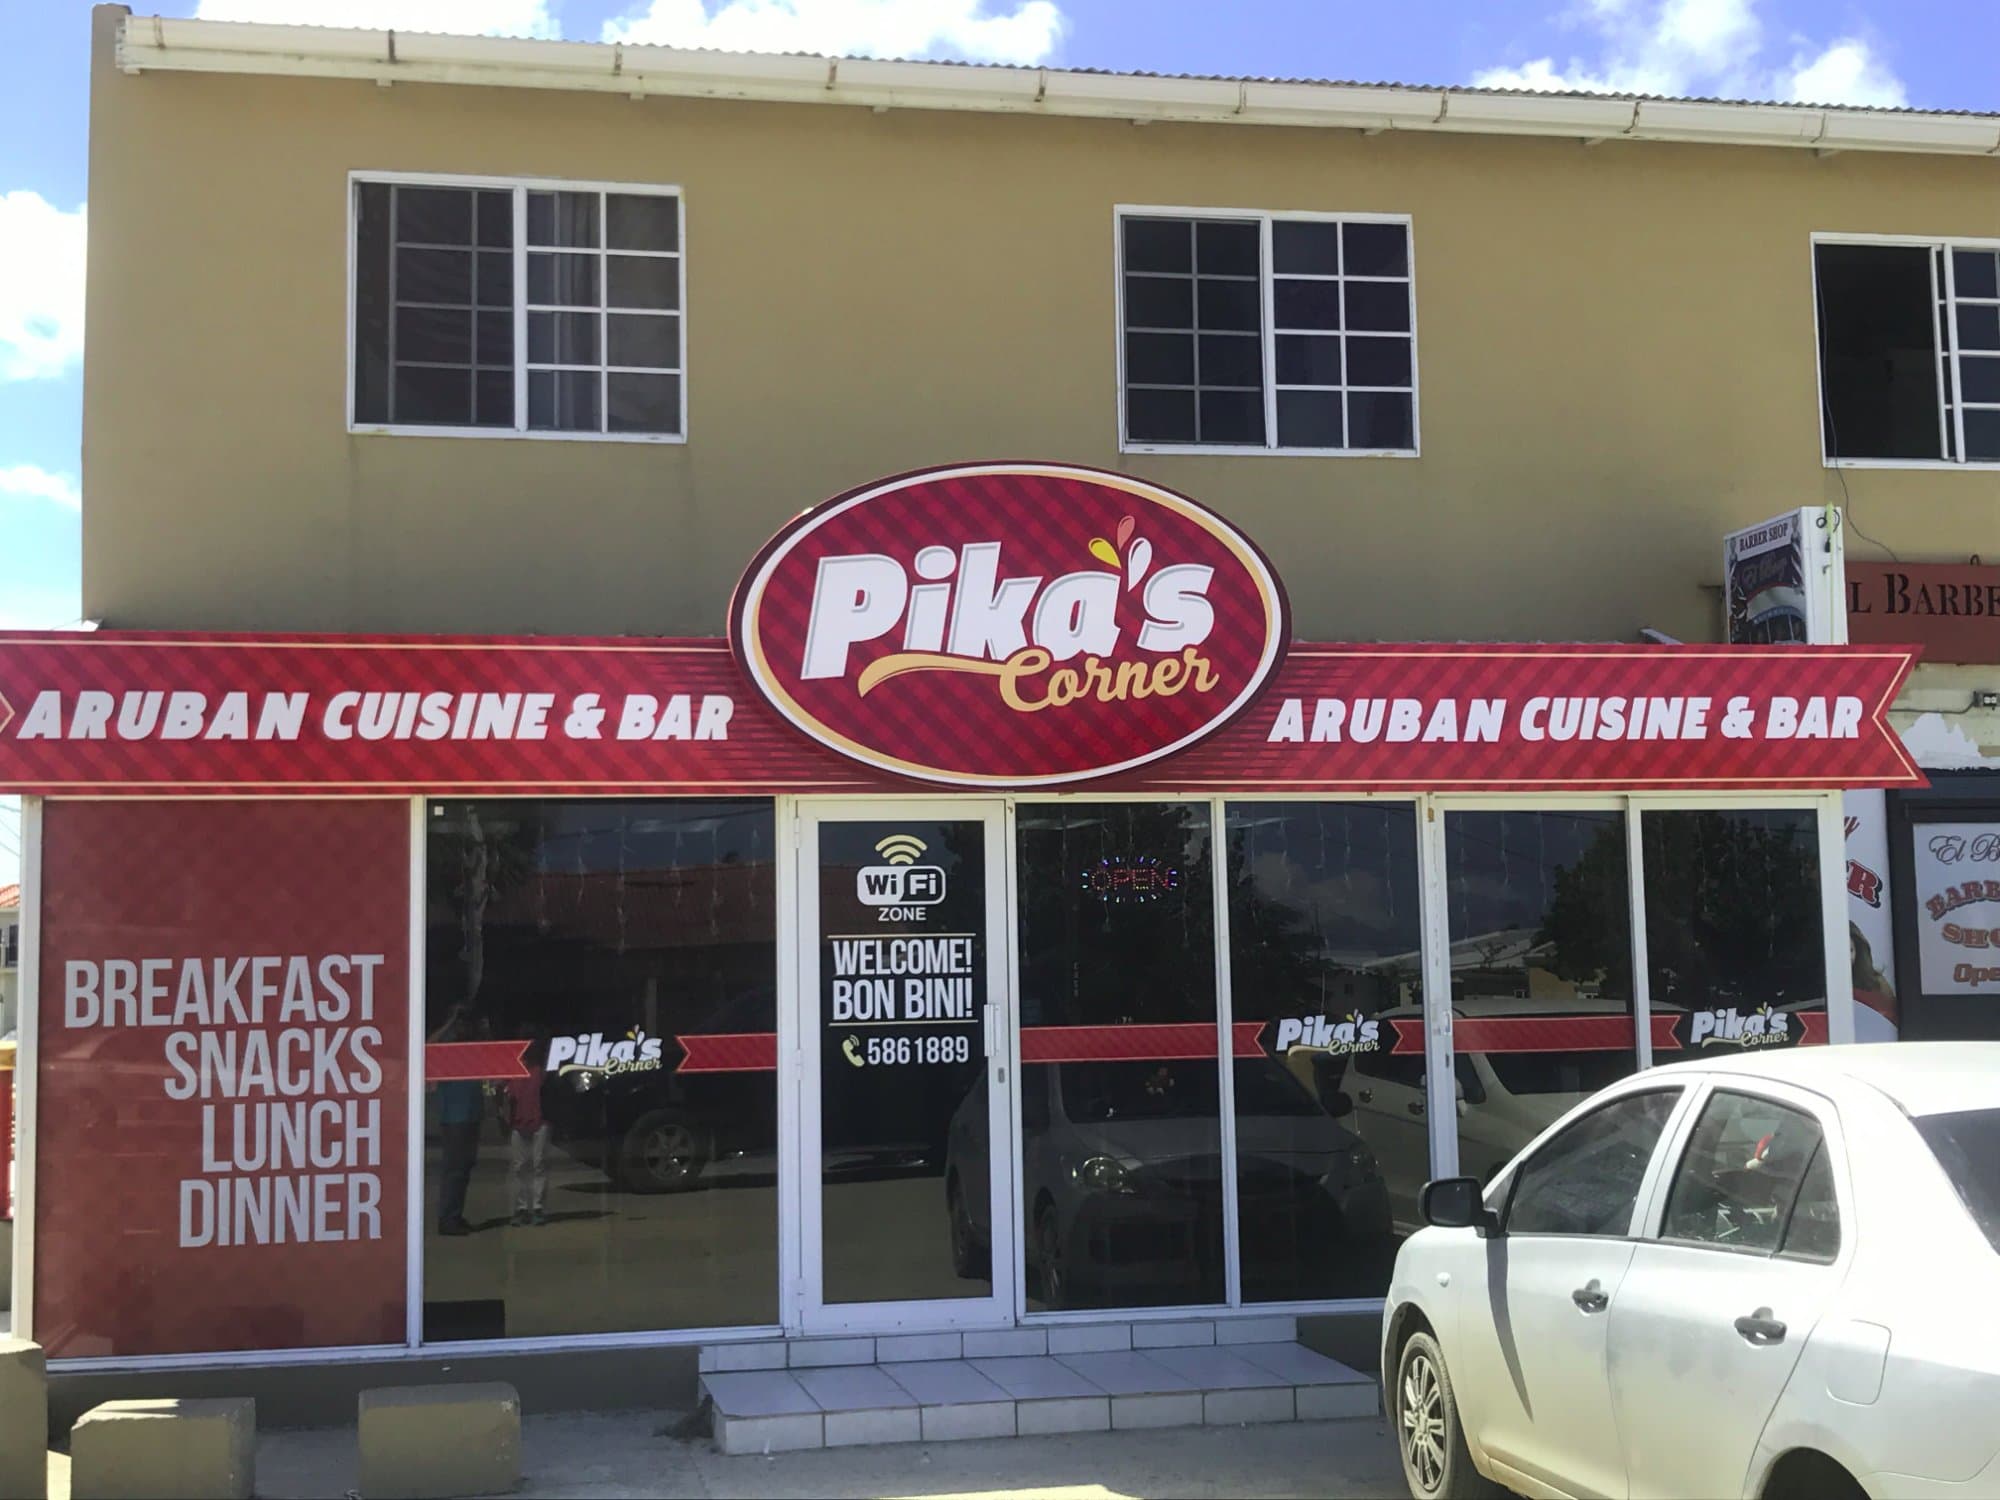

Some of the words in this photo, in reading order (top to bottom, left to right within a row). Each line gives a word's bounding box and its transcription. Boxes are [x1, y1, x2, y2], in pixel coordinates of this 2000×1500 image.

[1739, 530, 1768, 552] BARBER
[1768, 523, 1788, 542] SHOP
[800, 537, 1215, 680] Pika's
[999, 646, 1220, 712] Corner
[17, 691, 310, 741] ARUBAN
[323, 691, 556, 741] CUISINE
[564, 693, 606, 741] &
[615, 694, 734, 741] BAR
[1267, 698, 1507, 743] ARUBAN
[1519, 696, 1712, 741] CUISINE
[1721, 696, 1754, 740] &
[1764, 697, 1864, 739] BAR
[1091, 867, 1172, 892] OPEN
[878, 907, 927, 922] ZONE
[832, 938, 973, 976] WELCOME!
[64, 953, 385, 1029] BREAKFAST
[832, 978, 895, 1020] BON
[904, 977, 973, 1019] BINI!
[1275, 1013, 1379, 1051] Pika's
[1690, 1006, 1788, 1044] Pika's
[1740, 1031, 1789, 1047] Corner
[163, 1026, 383, 1101] SNACKS
[546, 1031, 663, 1071] Pika's
[604, 1056, 663, 1075] Corner
[1328, 1039, 1380, 1056] Corner
[201, 1099, 382, 1174] LUNCH
[179, 1172, 383, 1249] DINNER
